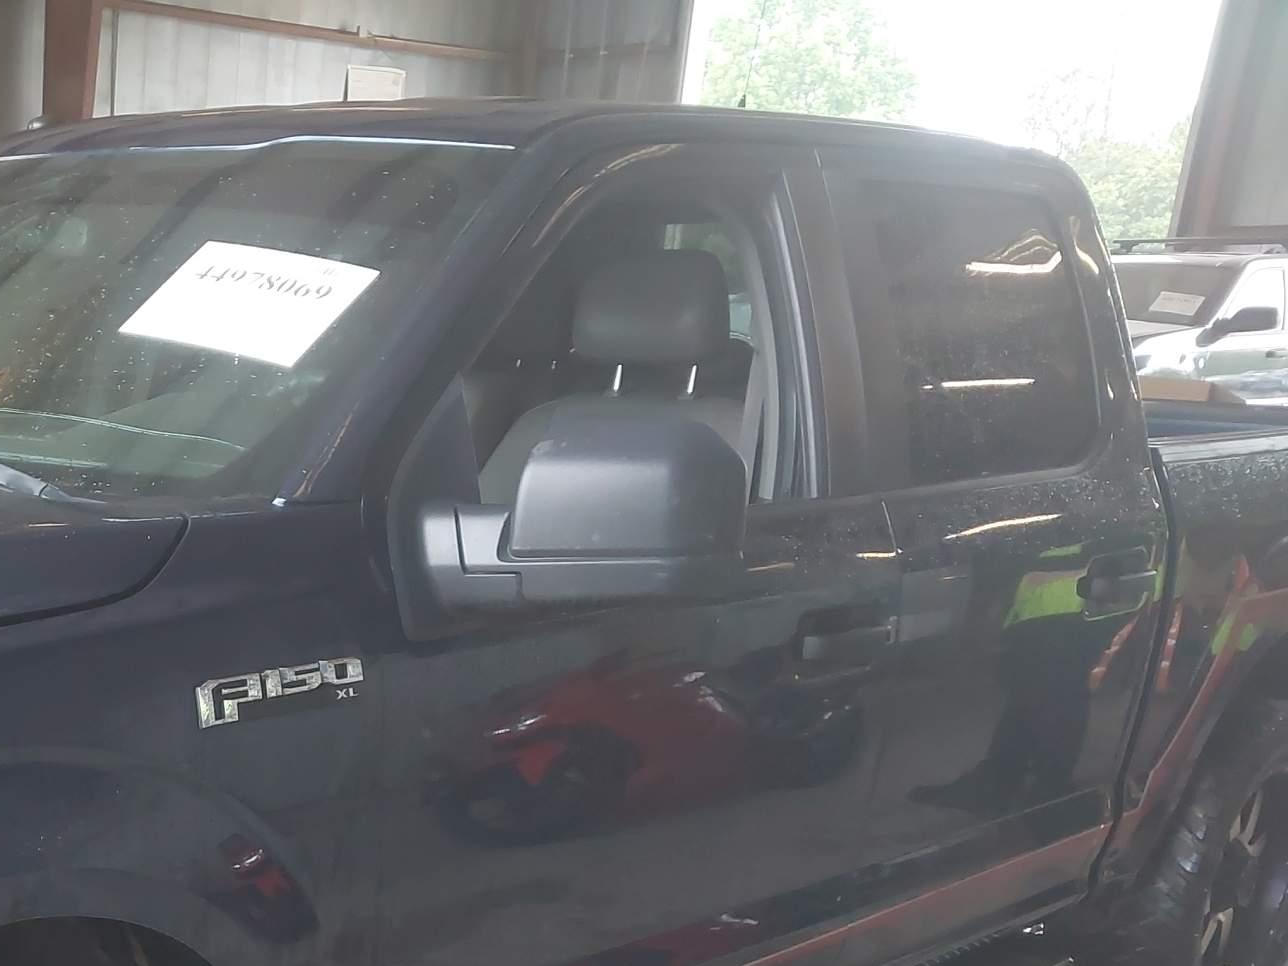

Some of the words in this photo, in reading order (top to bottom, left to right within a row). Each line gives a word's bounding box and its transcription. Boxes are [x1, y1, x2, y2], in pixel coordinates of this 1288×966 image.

[197, 265, 333, 300] 44978069
[195, 656, 365, 729] F150
[335, 687, 359, 701] XL
